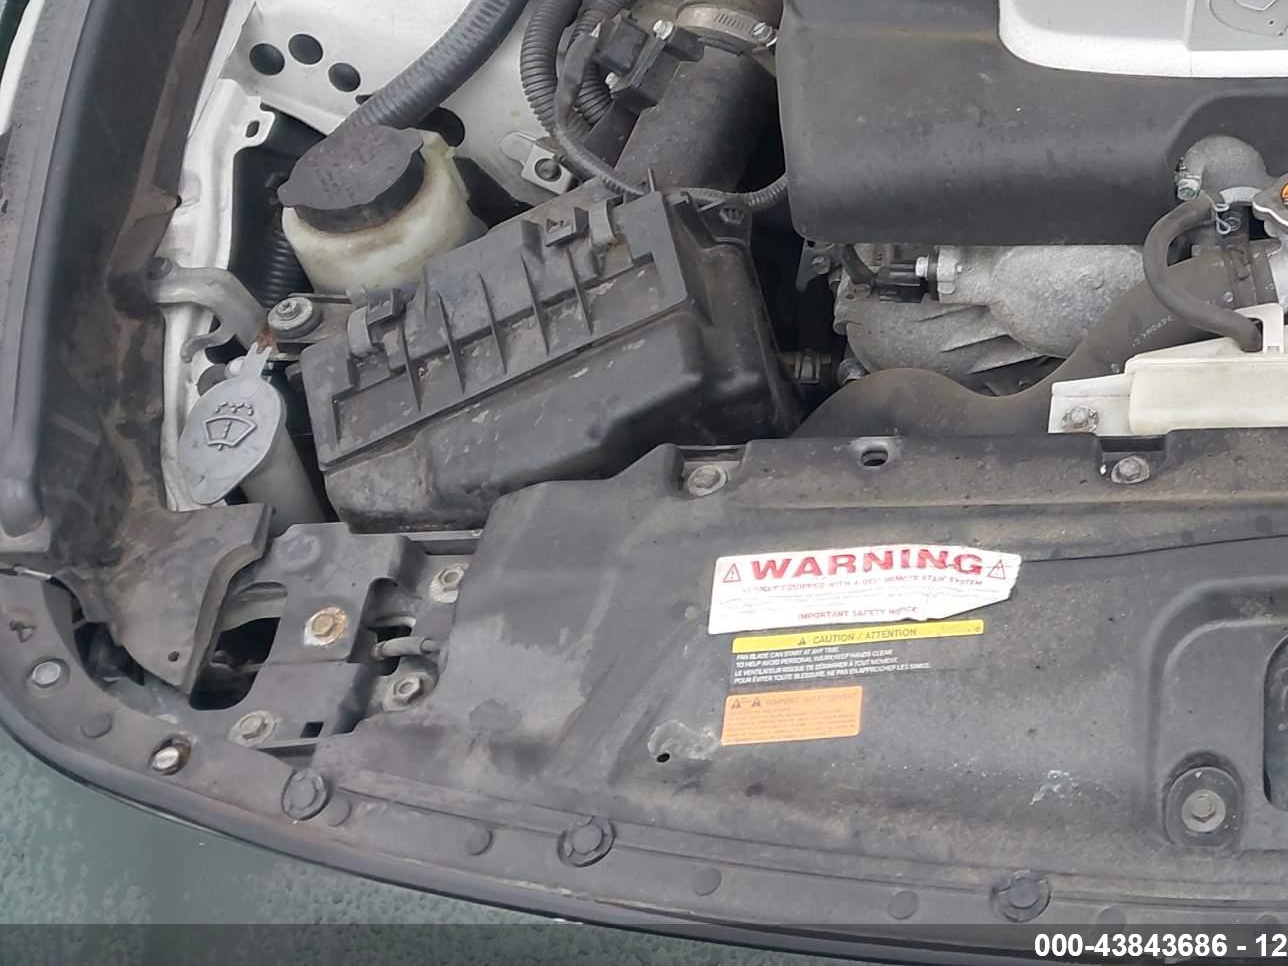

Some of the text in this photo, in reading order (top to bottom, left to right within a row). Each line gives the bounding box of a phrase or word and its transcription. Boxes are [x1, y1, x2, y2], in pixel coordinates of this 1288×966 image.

[751, 548, 984, 581] WARNING
[798, 610, 849, 620] IMPORTANT
[813, 633, 855, 645] CAUTION
[865, 628, 917, 640] ATTENTION
